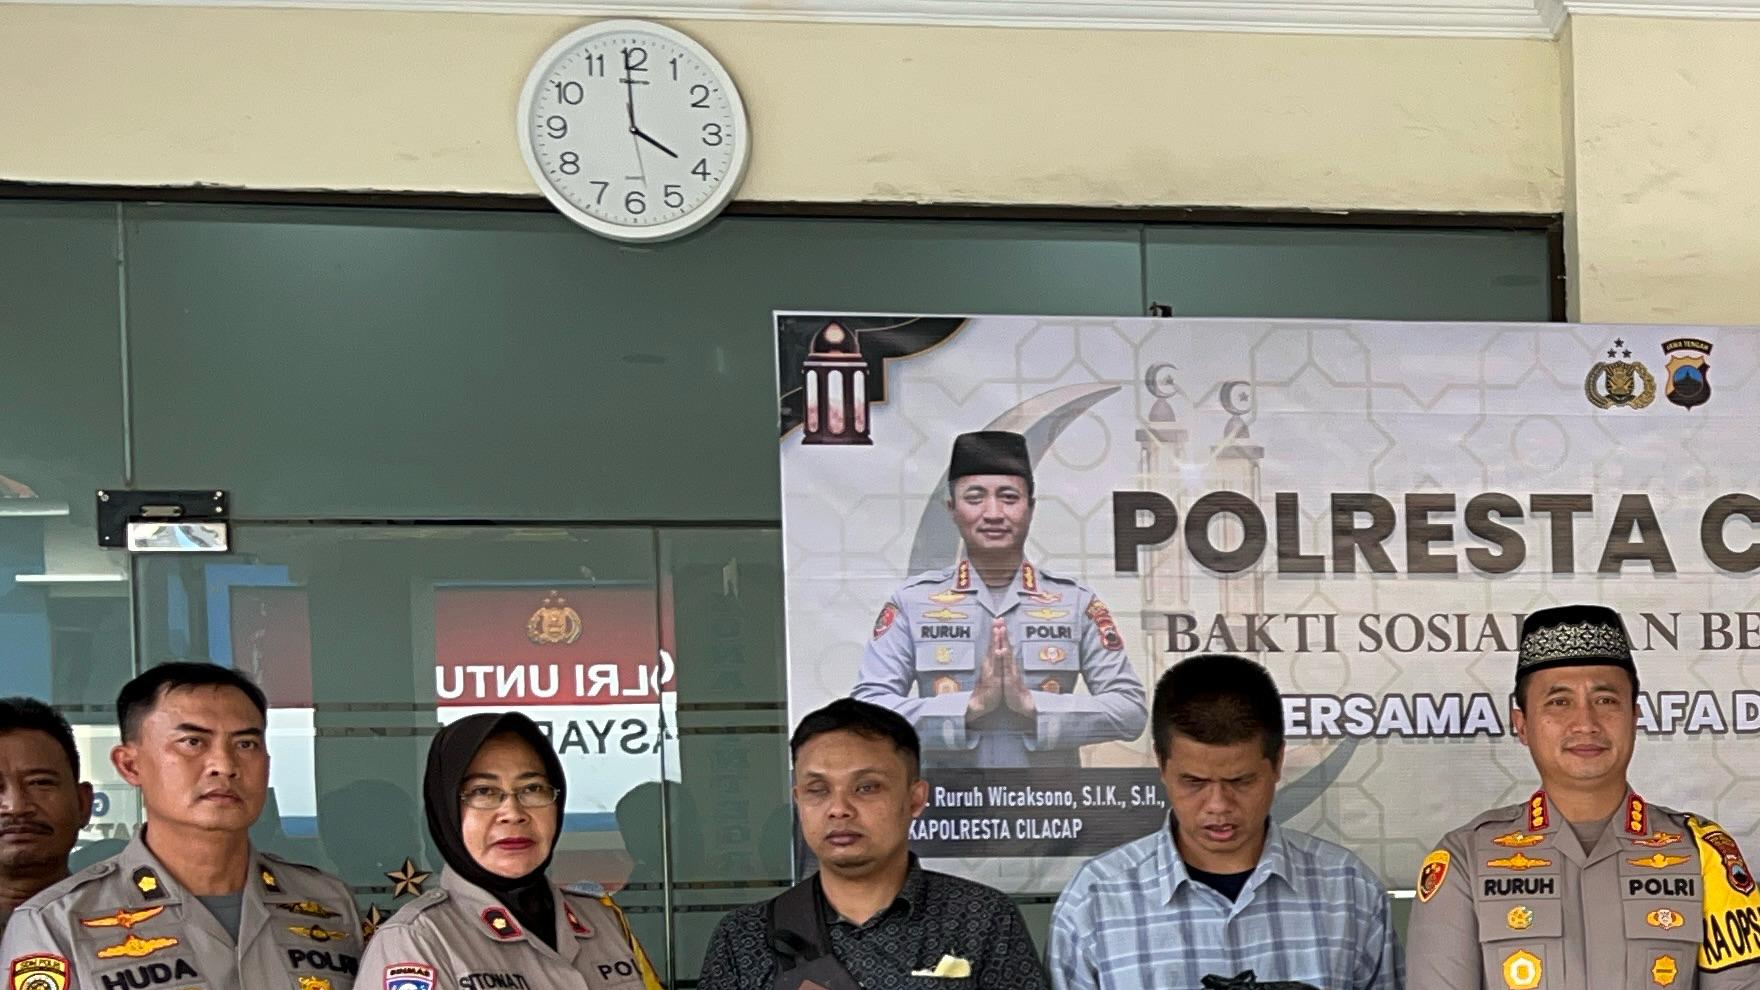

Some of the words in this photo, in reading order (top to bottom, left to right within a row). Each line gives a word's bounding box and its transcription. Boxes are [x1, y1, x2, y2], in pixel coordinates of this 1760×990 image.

[585, 53, 605, 77] 11
[621, 47, 648, 71] 12
[669, 57, 678, 81] 1
[555, 81, 584, 105] 10
[690, 84, 710, 108] 2
[546, 115, 567, 139] 9
[702, 123, 723, 146] 3
[559, 152, 580, 175] 8
[691, 158, 711, 181] 4
[590, 181, 609, 204] 7
[625, 191, 646, 214] 6
[664, 185, 684, 208] 5
[1112, 490, 1677, 575] POLRESTA
[921, 626, 970, 638] RURUH
[1026, 626, 1072, 639] POLRI
[1165, 613, 1339, 653] BAKTI
[1283, 694, 1504, 738] ERSAMA
[935, 786, 983, 807] Ruruh
[988, 786, 1078, 809] Wicaksono,
[1082, 786, 1126, 808] S.I.K.,
[1015, 818, 1082, 839] CILACAP
[1484, 878, 1554, 896] RURUH
[1629, 878, 1695, 897] POLRI
[287, 949, 359, 977] POLR
